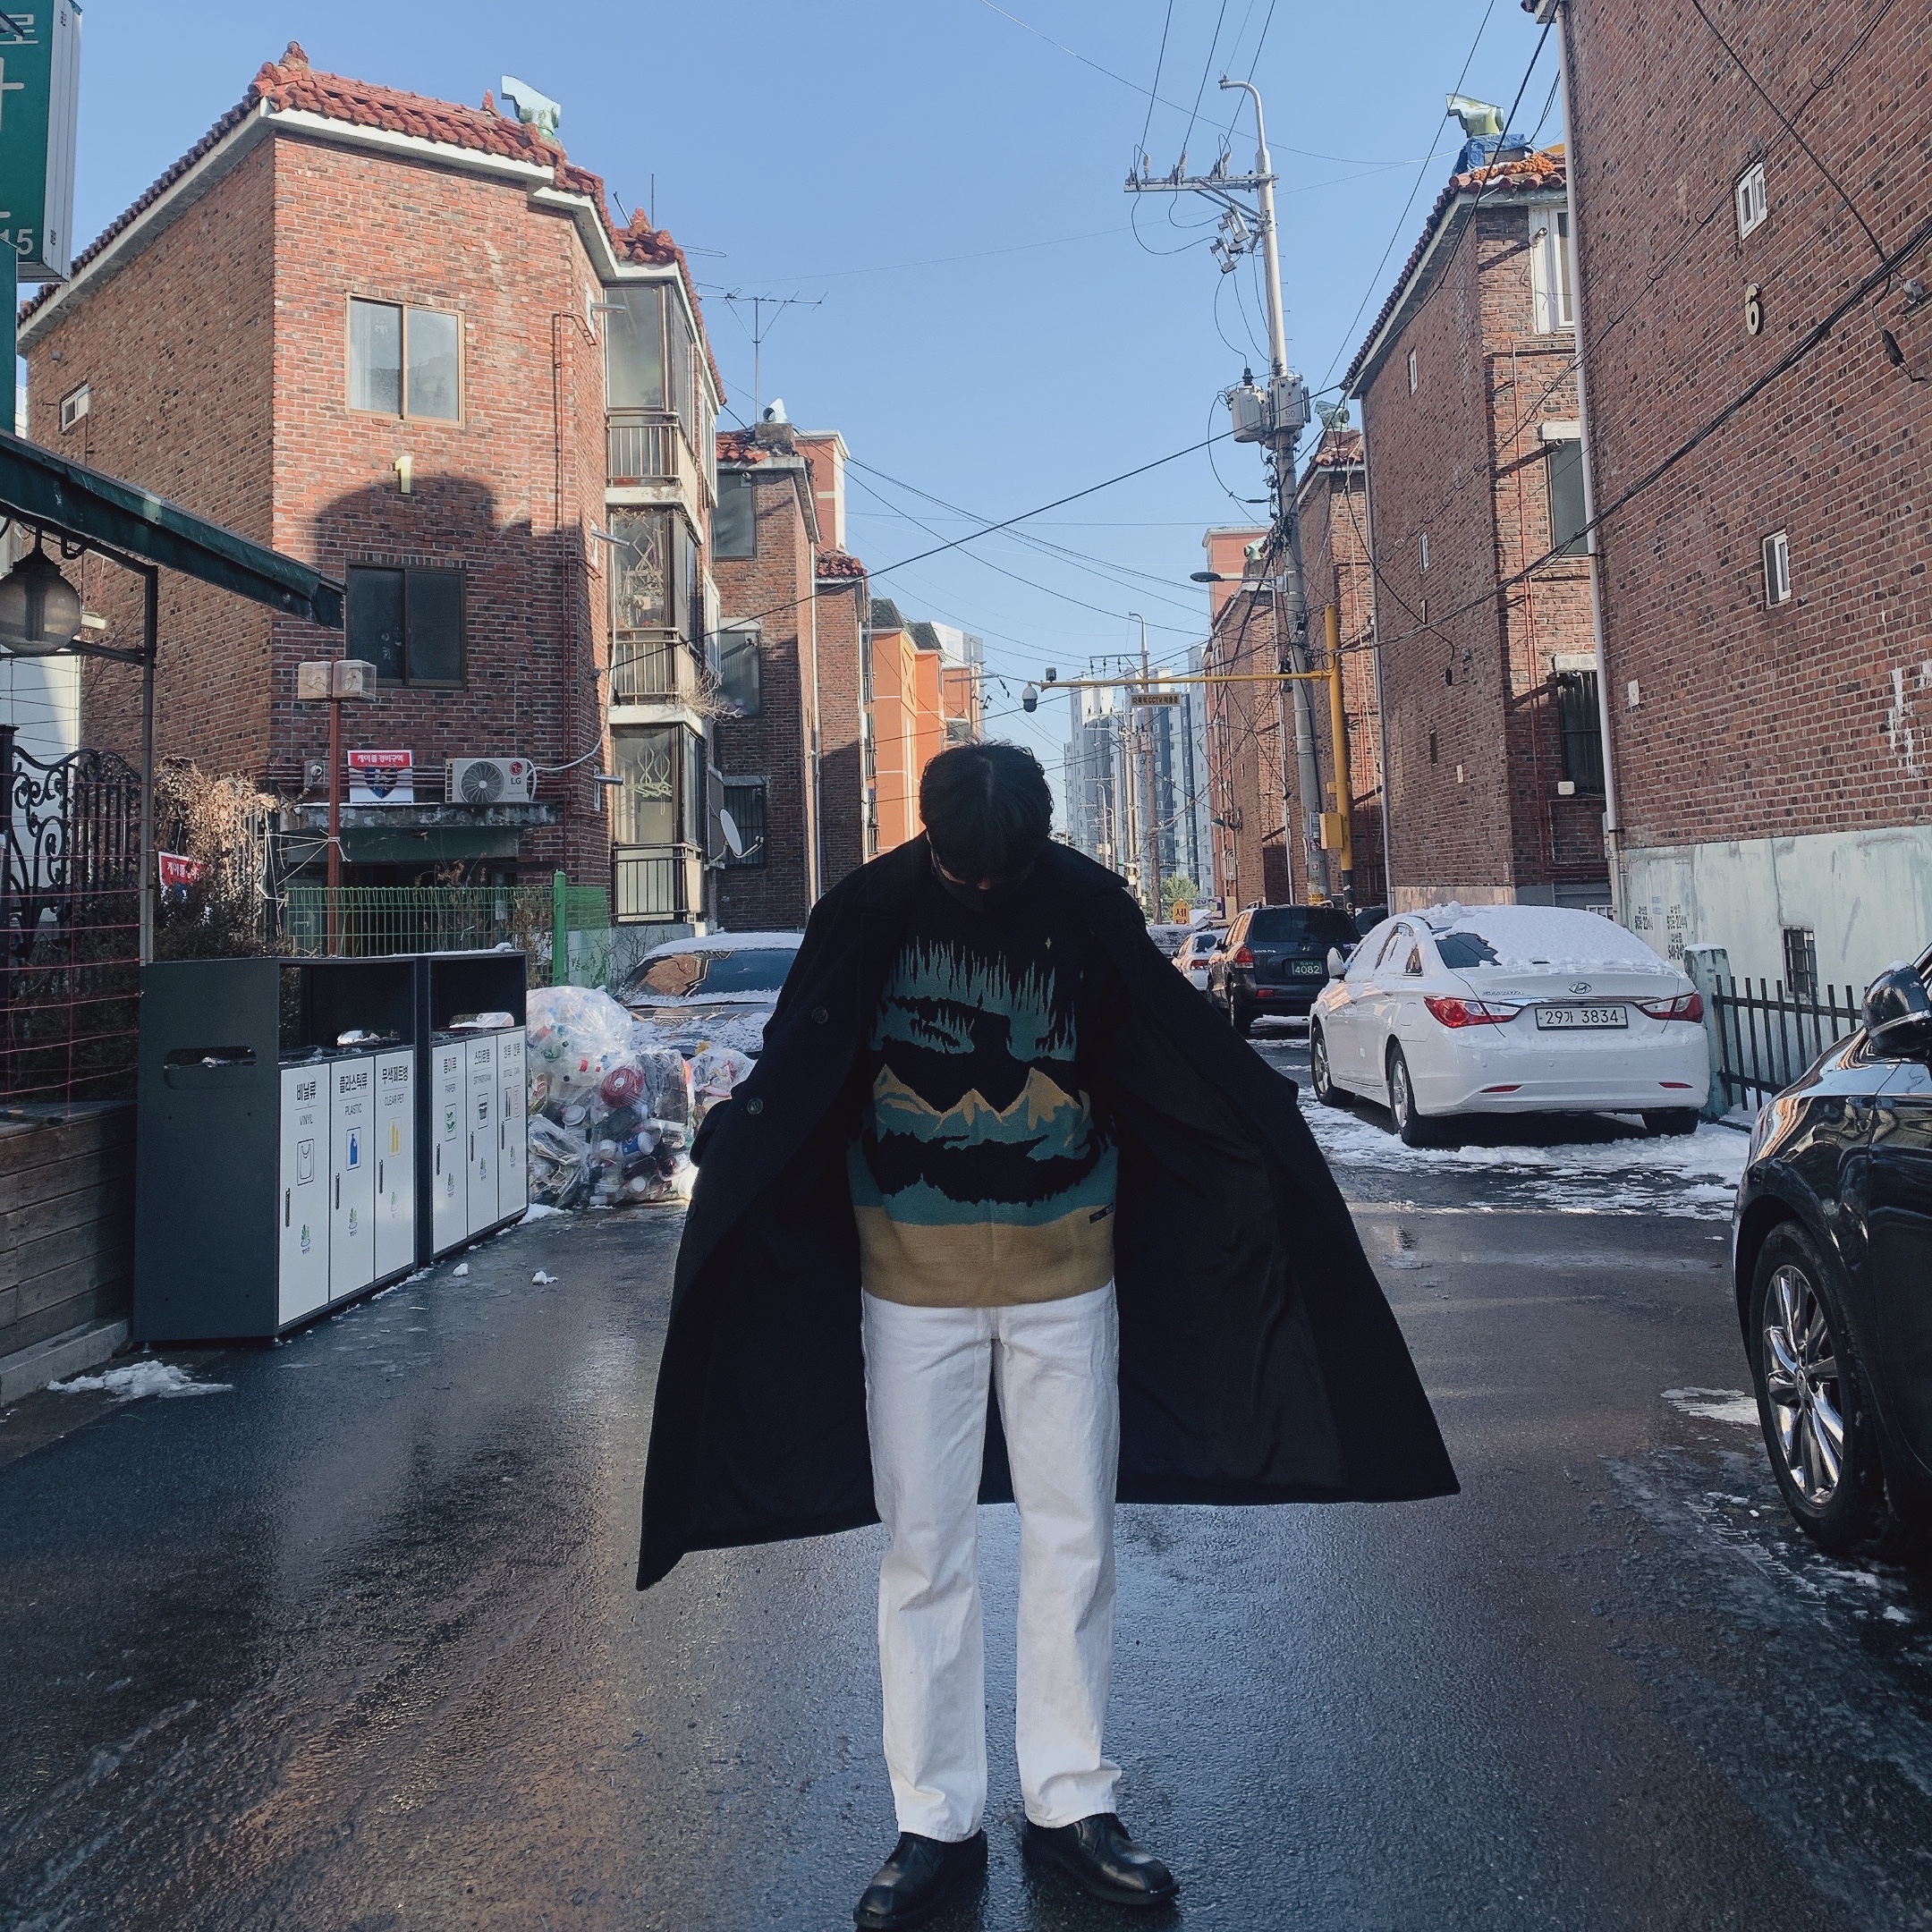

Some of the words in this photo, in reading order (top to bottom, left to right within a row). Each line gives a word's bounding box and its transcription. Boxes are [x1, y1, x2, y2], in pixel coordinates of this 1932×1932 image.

[1745, 283, 1761, 335] 6
[1285, 410, 1295, 419] 50
[395, 455, 411, 493] 1
[1148, 696, 1162, 704] CCTV
[378, 754, 403, 763] 경비구역
[511, 777, 521, 785] LG
[1294, 965, 1320, 975] 4082
[1545, 1010, 1574, 1024] 29가
[1580, 1009, 1619, 1024] 3834
[443, 1056, 457, 1074] 종이류
[381, 1064, 409, 1085] 무색페트병
[339, 1072, 368, 1094] 플라스틱류
[296, 1080, 317, 1101] 비닐류
[384, 1094, 397, 1106] CLEAR
[397, 1093, 405, 1104] PET
[344, 1103, 362, 1116] PLASTIC
[299, 1114, 314, 1126] VINYL
